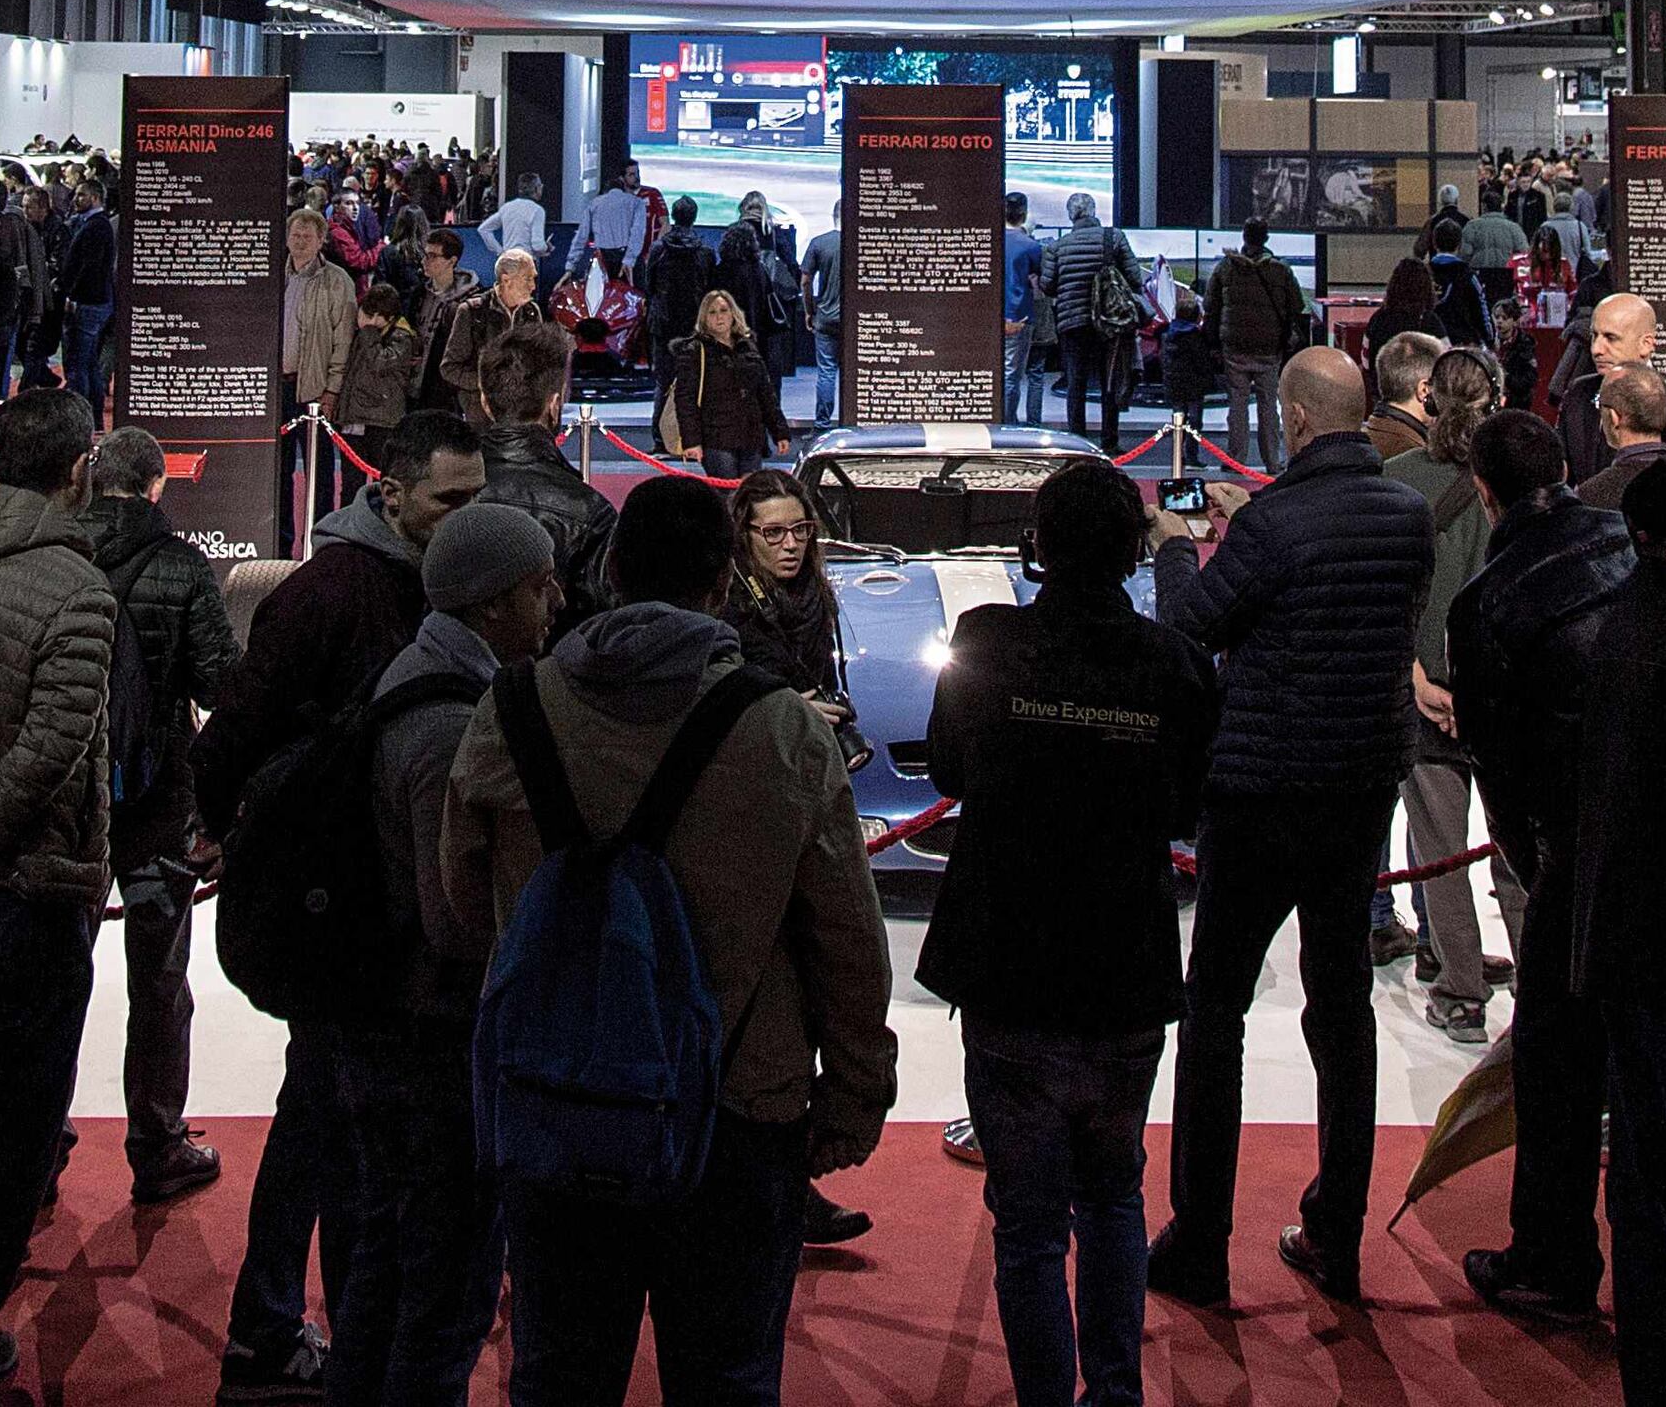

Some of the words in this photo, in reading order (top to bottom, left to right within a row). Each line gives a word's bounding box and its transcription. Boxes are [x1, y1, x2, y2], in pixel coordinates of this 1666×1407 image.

[137, 124, 205, 138] FERRARI
[209, 125, 244, 138] Dino
[247, 125, 274, 138] 246
[136, 139, 217, 153] TASMANIA
[859, 135, 928, 149] FERRARI
[931, 135, 957, 149] 250
[961, 135, 993, 149] GTO
[199, 543, 258, 559] ASSICA
[1011, 696, 1058, 717] Drive
[1060, 700, 1160, 727] Experience
